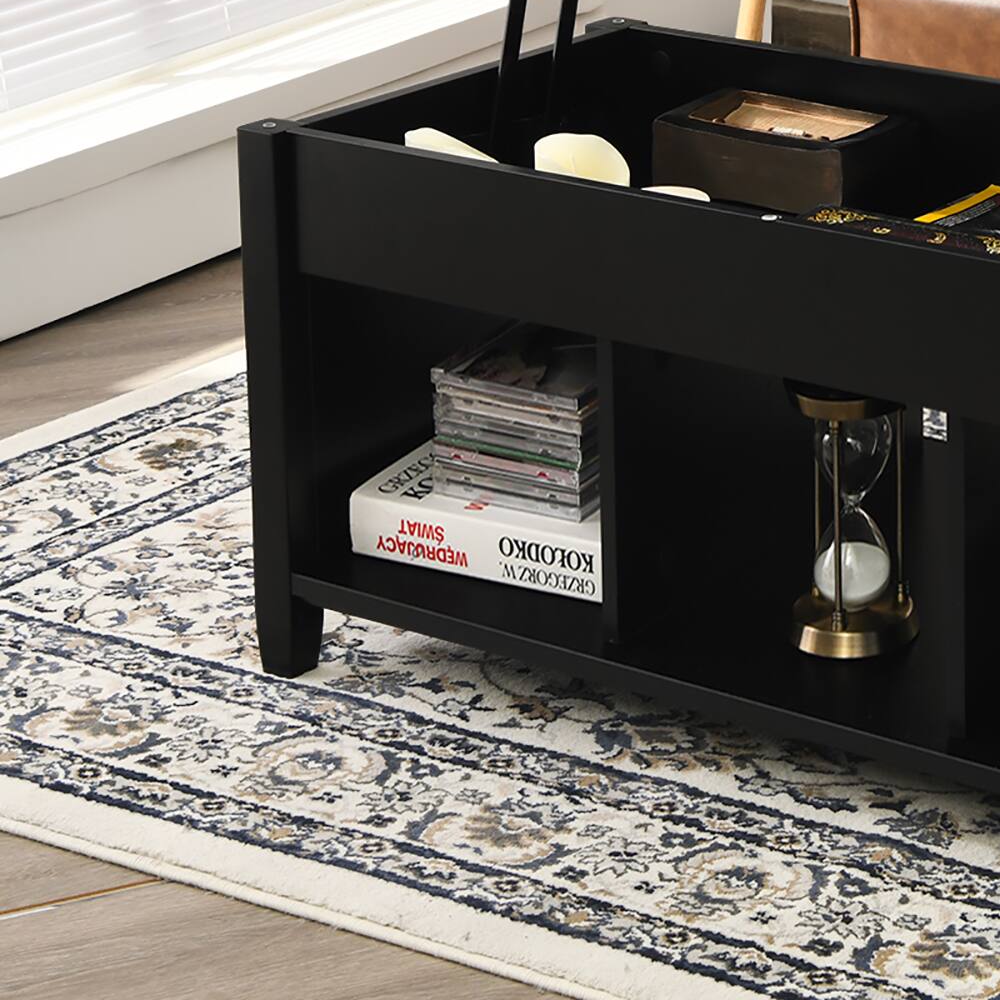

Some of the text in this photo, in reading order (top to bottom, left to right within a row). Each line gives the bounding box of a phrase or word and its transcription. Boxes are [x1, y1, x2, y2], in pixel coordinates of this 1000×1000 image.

[398, 519, 445, 545] ŚWIAT
[499, 536, 595, 573] KOŁODKO
[518, 567, 596, 596] GRZEGORZ
